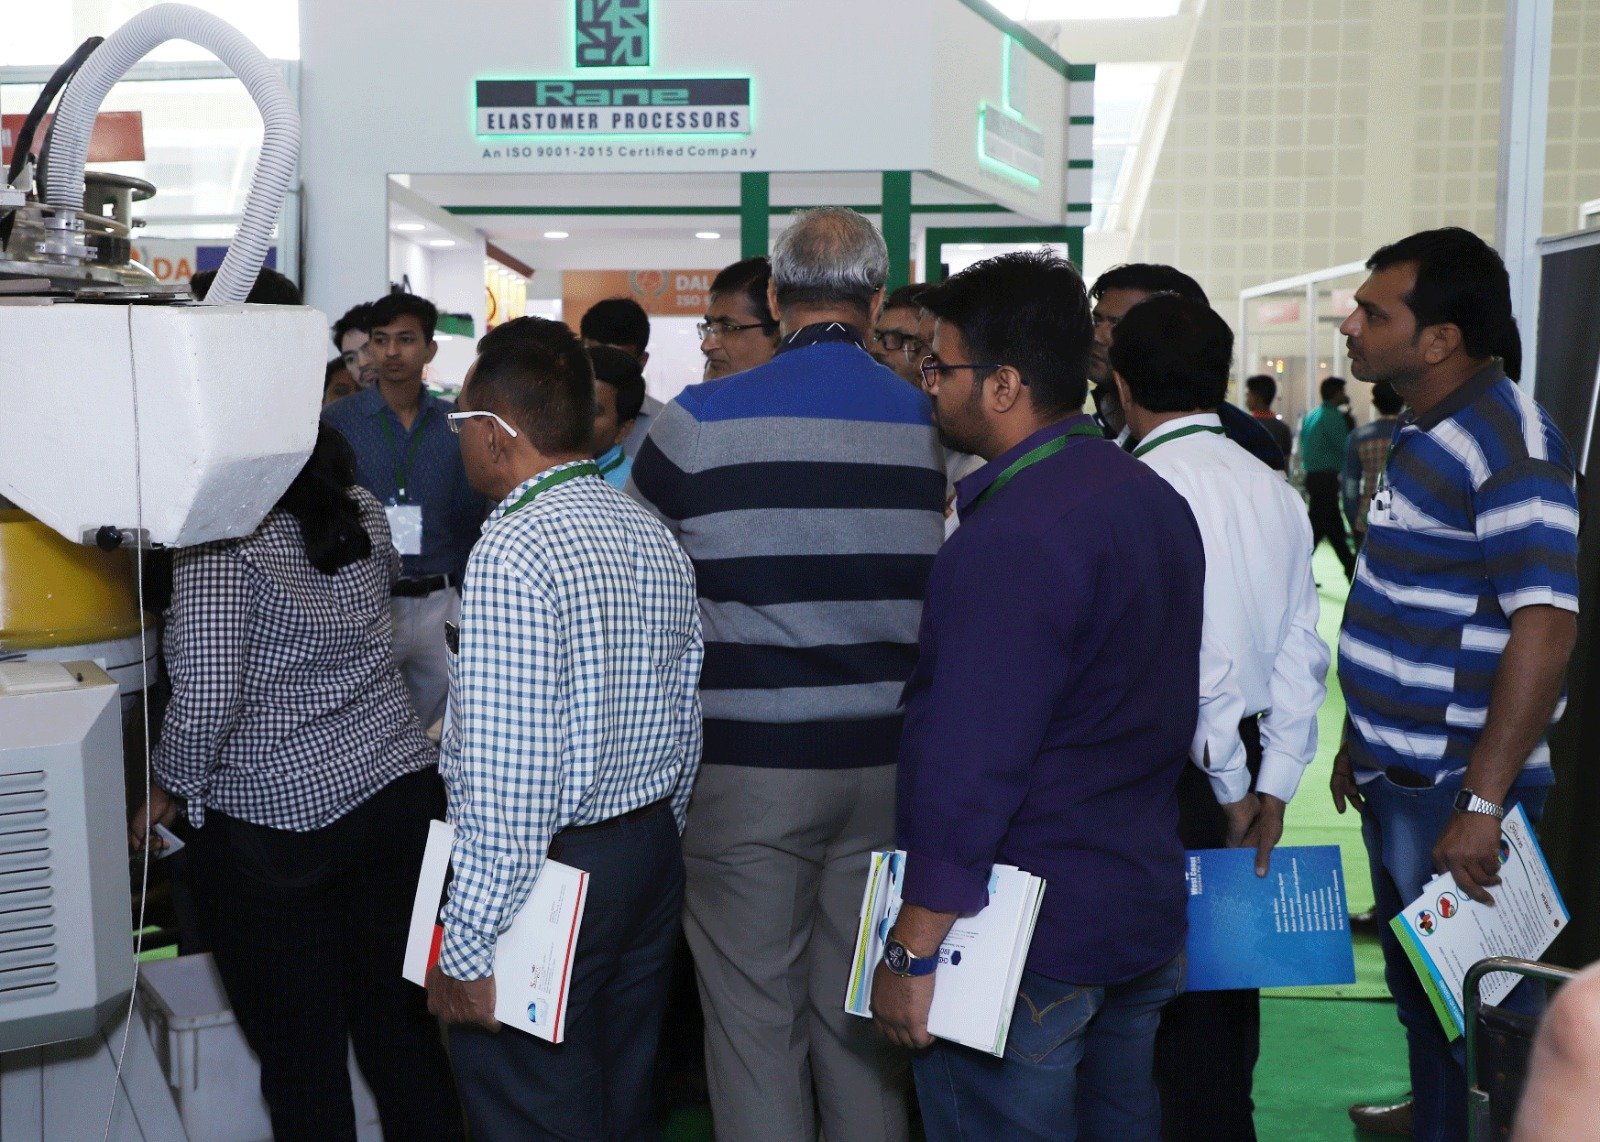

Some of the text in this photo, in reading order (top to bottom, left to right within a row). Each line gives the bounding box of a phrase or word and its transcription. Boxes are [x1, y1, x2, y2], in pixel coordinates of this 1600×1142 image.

[535, 80, 690, 107] Rane
[487, 110, 741, 131] ELASTOMER PROCESSORS
[481, 144, 758, 159] An ISO 9001-2015 Certified Company
